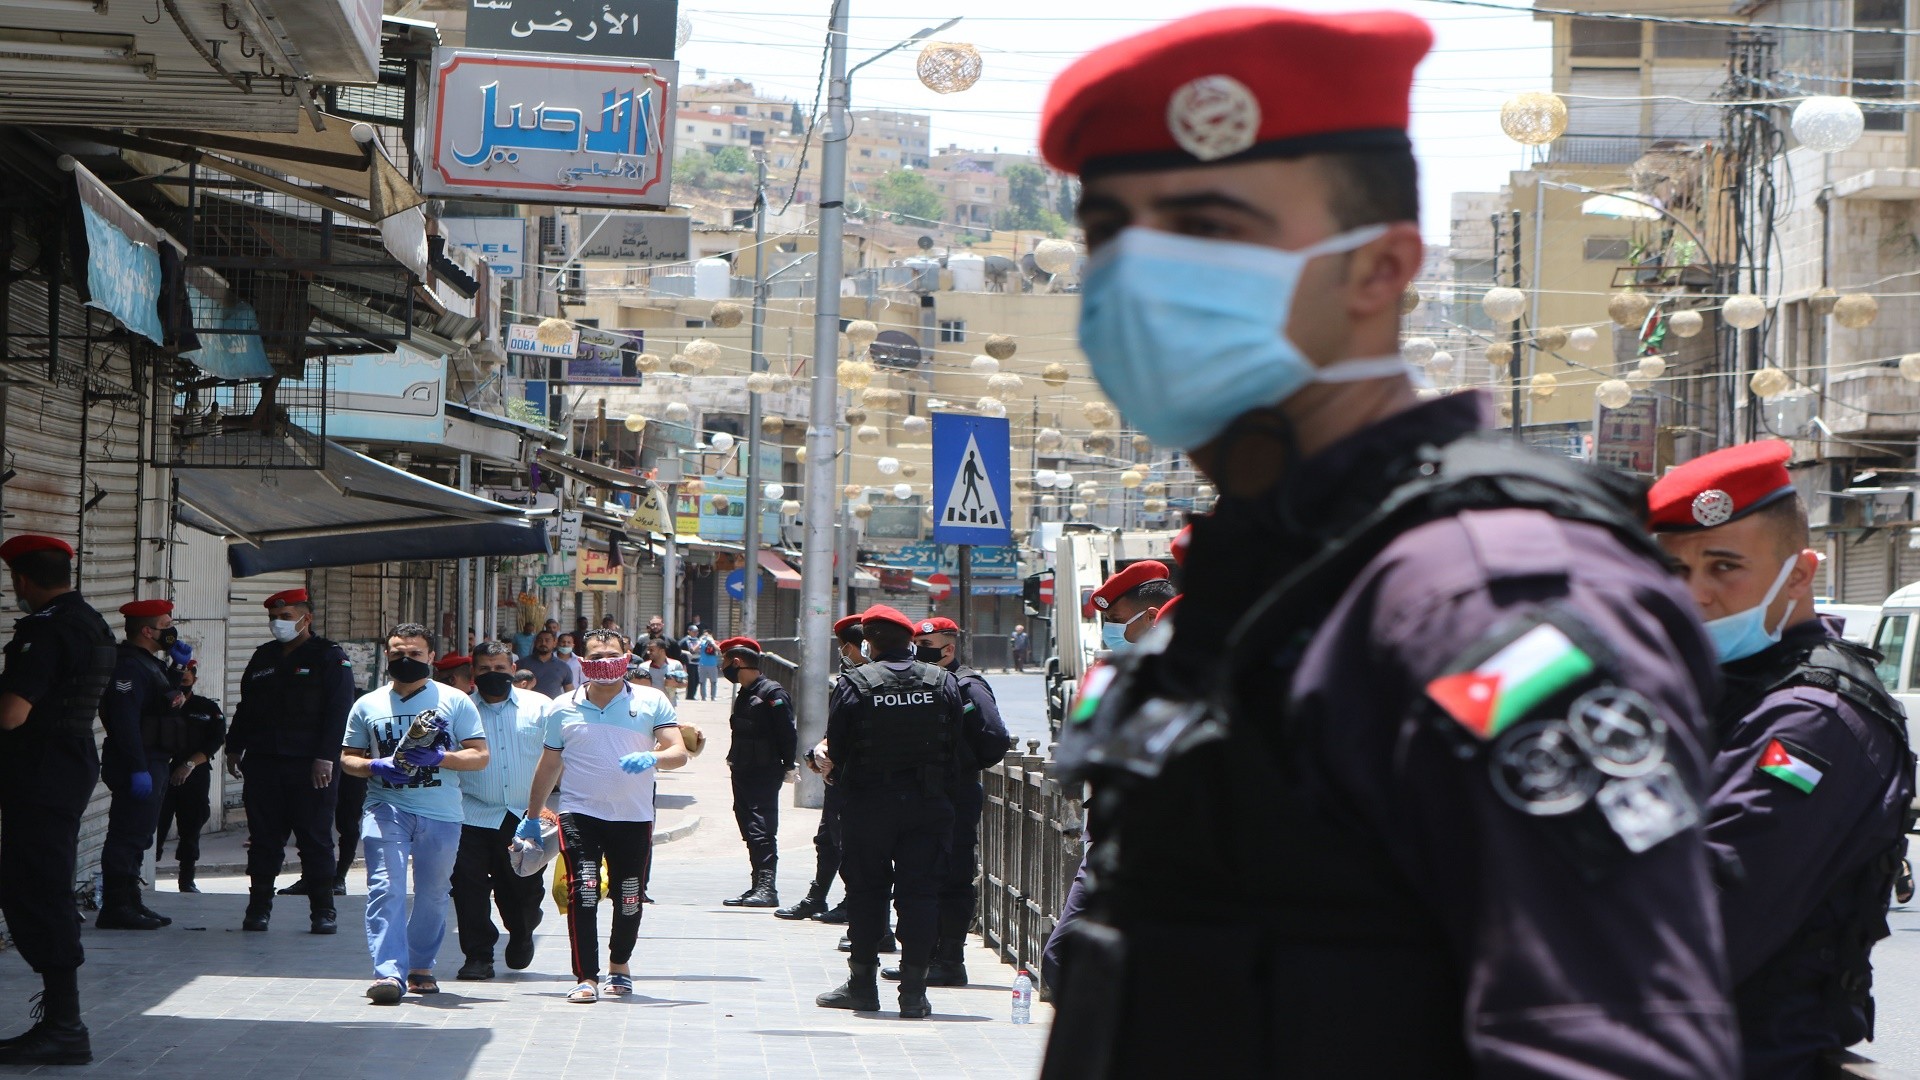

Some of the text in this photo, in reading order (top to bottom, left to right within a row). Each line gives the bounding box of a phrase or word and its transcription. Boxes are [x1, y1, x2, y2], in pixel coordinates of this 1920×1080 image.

[511, 4, 639, 42] الأرض
[622, 235, 648, 247] شركة
[640, 247, 652, 259] أبو
[655, 251, 685, 260] موسى
[970, 551, 1017, 567] الإخلا
[873, 692, 934, 706] POLICE
